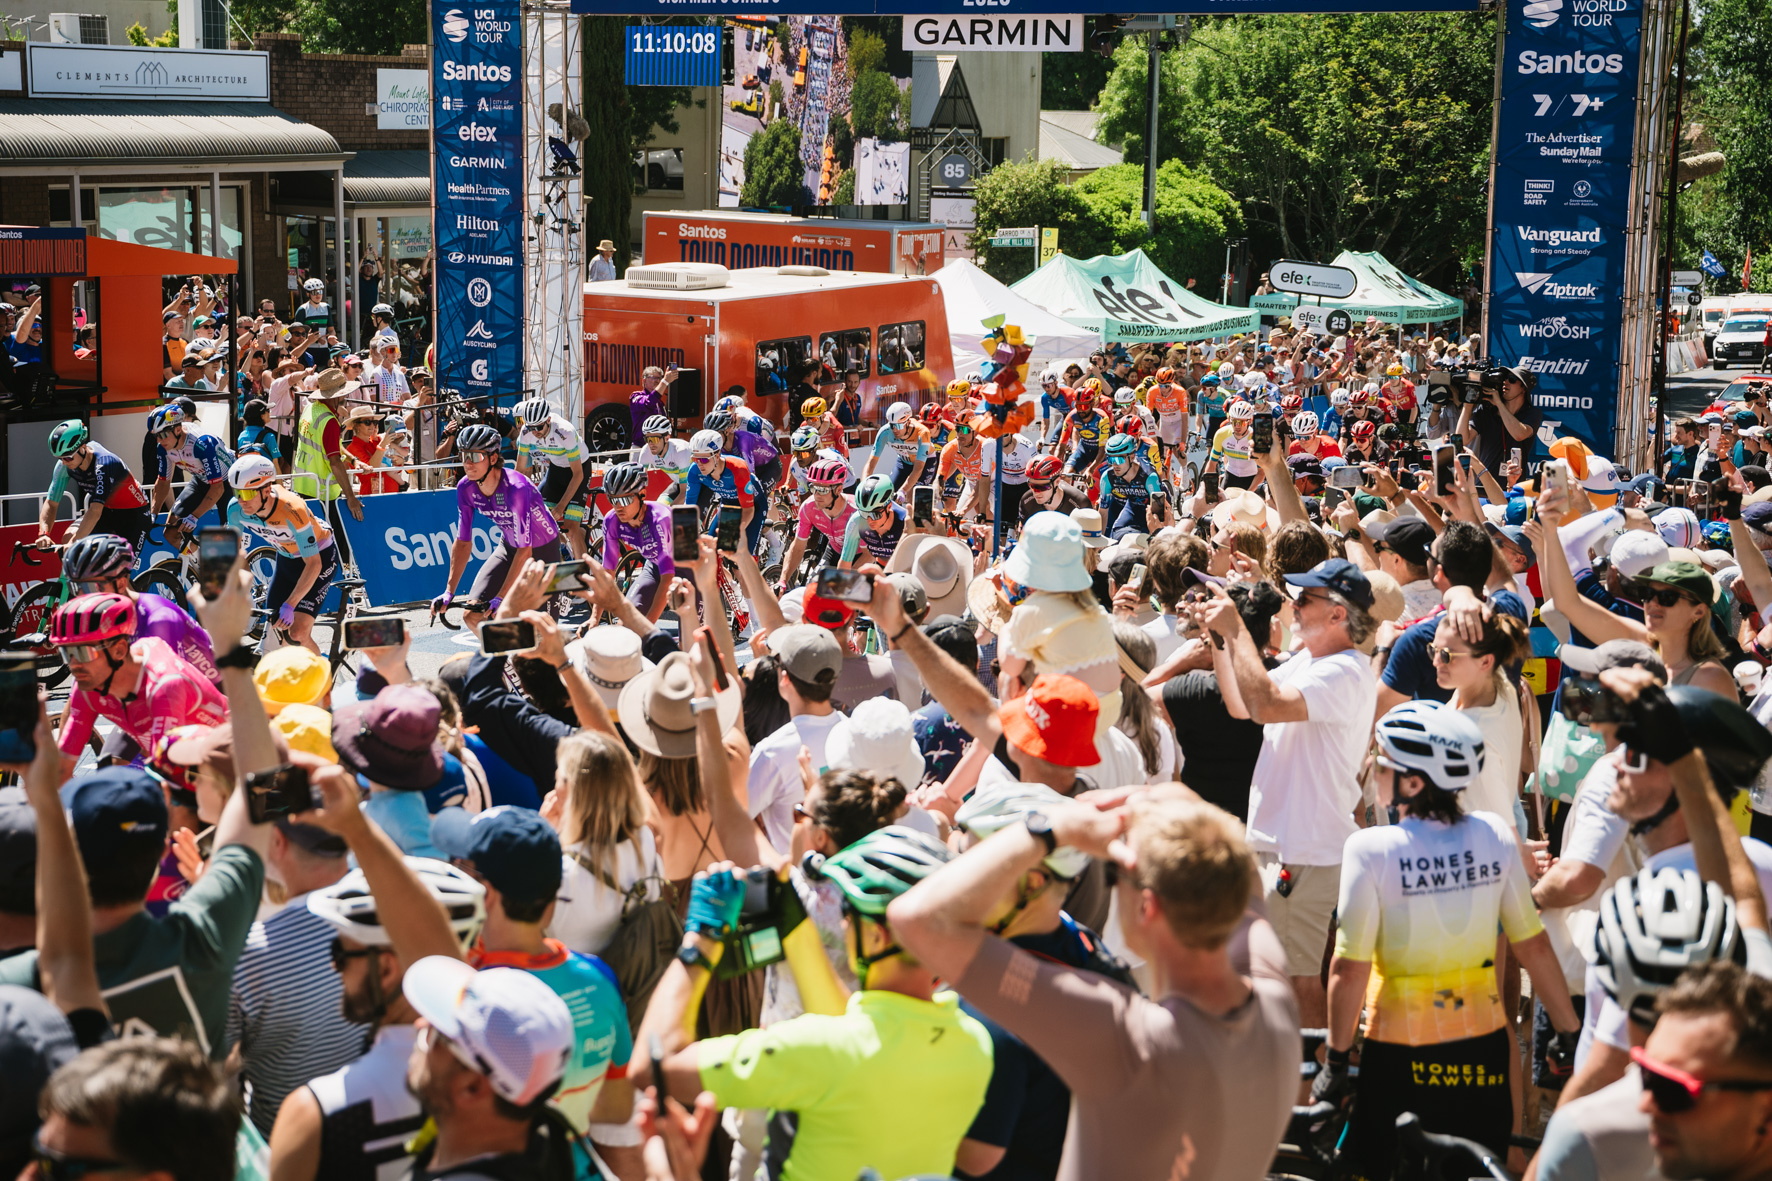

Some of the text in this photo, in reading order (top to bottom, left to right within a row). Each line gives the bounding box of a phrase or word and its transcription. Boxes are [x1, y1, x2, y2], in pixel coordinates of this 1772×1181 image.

[474, 9, 495, 20] UCI
[1572, 0, 1627, 13] WORLD
[474, 20, 511, 32] WORLD
[1572, 14, 1612, 27] TOUR
[474, 32, 503, 43] TOUR
[914, 19, 1071, 46] GARMIN
[633, 33, 716, 53] 11:10:08
[1518, 50, 1623, 74] Santos
[56, 71, 248, 84] CLEMENTS ARCHITECTURE
[443, 60, 512, 82] Santos
[388, 84, 410, 99] Mount
[1532, 94, 1553, 116] 7
[459, 122, 497, 142] efex
[1525, 132, 1602, 143] The Advertiser
[1540, 146, 1602, 158] Sunday Mail
[944, 163, 965, 178] 85
[448, 183, 510, 195] Health Partners
[457, 215, 499, 231] Hilton
[678, 223, 727, 239] Santos
[1518, 226, 1600, 246] Vanguard
[25, 240, 53, 274] DOWN
[55, 240, 84, 272] UNDER
[407, 245, 428, 253] CENTRE
[1043, 248, 1055, 256] 37
[1530, 247, 1552, 255] Strong
[1567, 248, 1591, 256] Steady
[467, 254, 513, 266] HYUNDAI
[1281, 271, 1312, 286] efex
[1543, 283, 1596, 299] Ziptrak
[1254, 302, 1282, 310] SMARTER
[1118, 325, 1154, 336] SMARTER
[1224, 315, 1252, 330] BUSINESS
[1299, 312, 1322, 323] efex
[1331, 317, 1346, 329] 25
[463, 340, 497, 349] AUSCYCLING
[601, 343, 640, 385] DOWN
[876, 384, 897, 395] Santos
[1531, 394, 1593, 410] IMANO
[202, 458, 213, 476] BOSS
[96, 464, 104, 495] Adecco
[1115, 488, 1147, 498] BAHRAIN
[530, 506, 554, 535] Jayco
[319, 562, 337, 580] NSN
[185, 644, 219, 682] Jayco
[151, 717, 178, 735] EF
[1429, 734, 1463, 750] KASK
[1400, 850, 1474, 872] HONES
[1402, 861, 1502, 889] LAWYERS
[1412, 1061, 1485, 1075] HONES
[1413, 1073, 1504, 1087] LAWYERS
